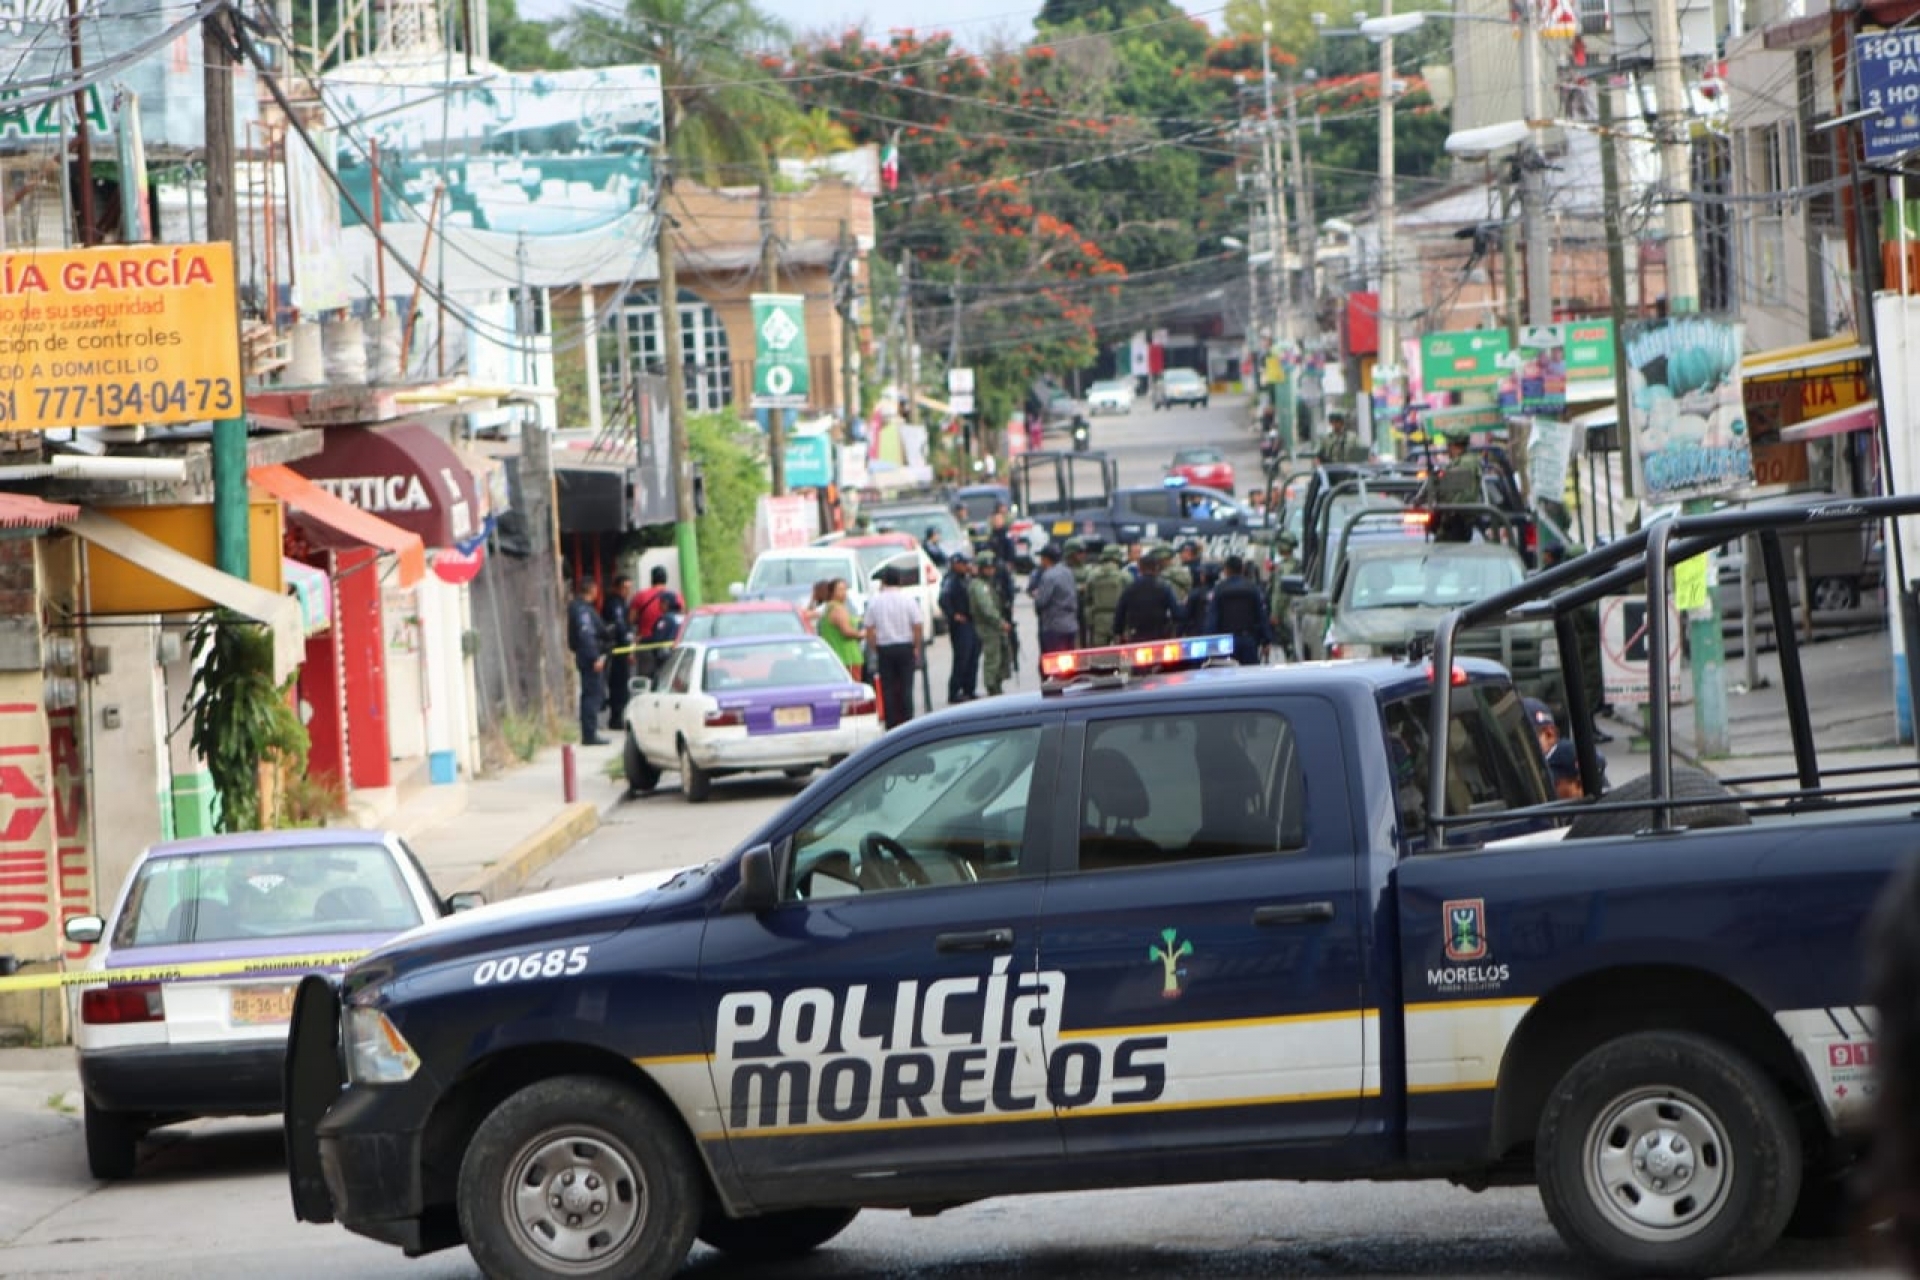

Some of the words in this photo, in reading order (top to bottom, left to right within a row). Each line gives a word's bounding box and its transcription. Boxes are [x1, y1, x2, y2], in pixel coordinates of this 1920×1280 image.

[62, 248, 214, 291] GARCÍA
[20, 301, 42, 319] de
[45, 303, 70, 320] su
[71, 294, 165, 323] seguridad
[44, 332, 68, 351] de
[77, 327, 181, 349] controles
[31, 362, 44, 378] A
[51, 356, 159, 378] DOMICILIO
[34, 377, 233, 421] 777-134-04-73
[473, 945, 591, 985] 00685
[1427, 964, 1510, 985] MORELOS
[730, 1036, 1168, 1129] MORELOS
